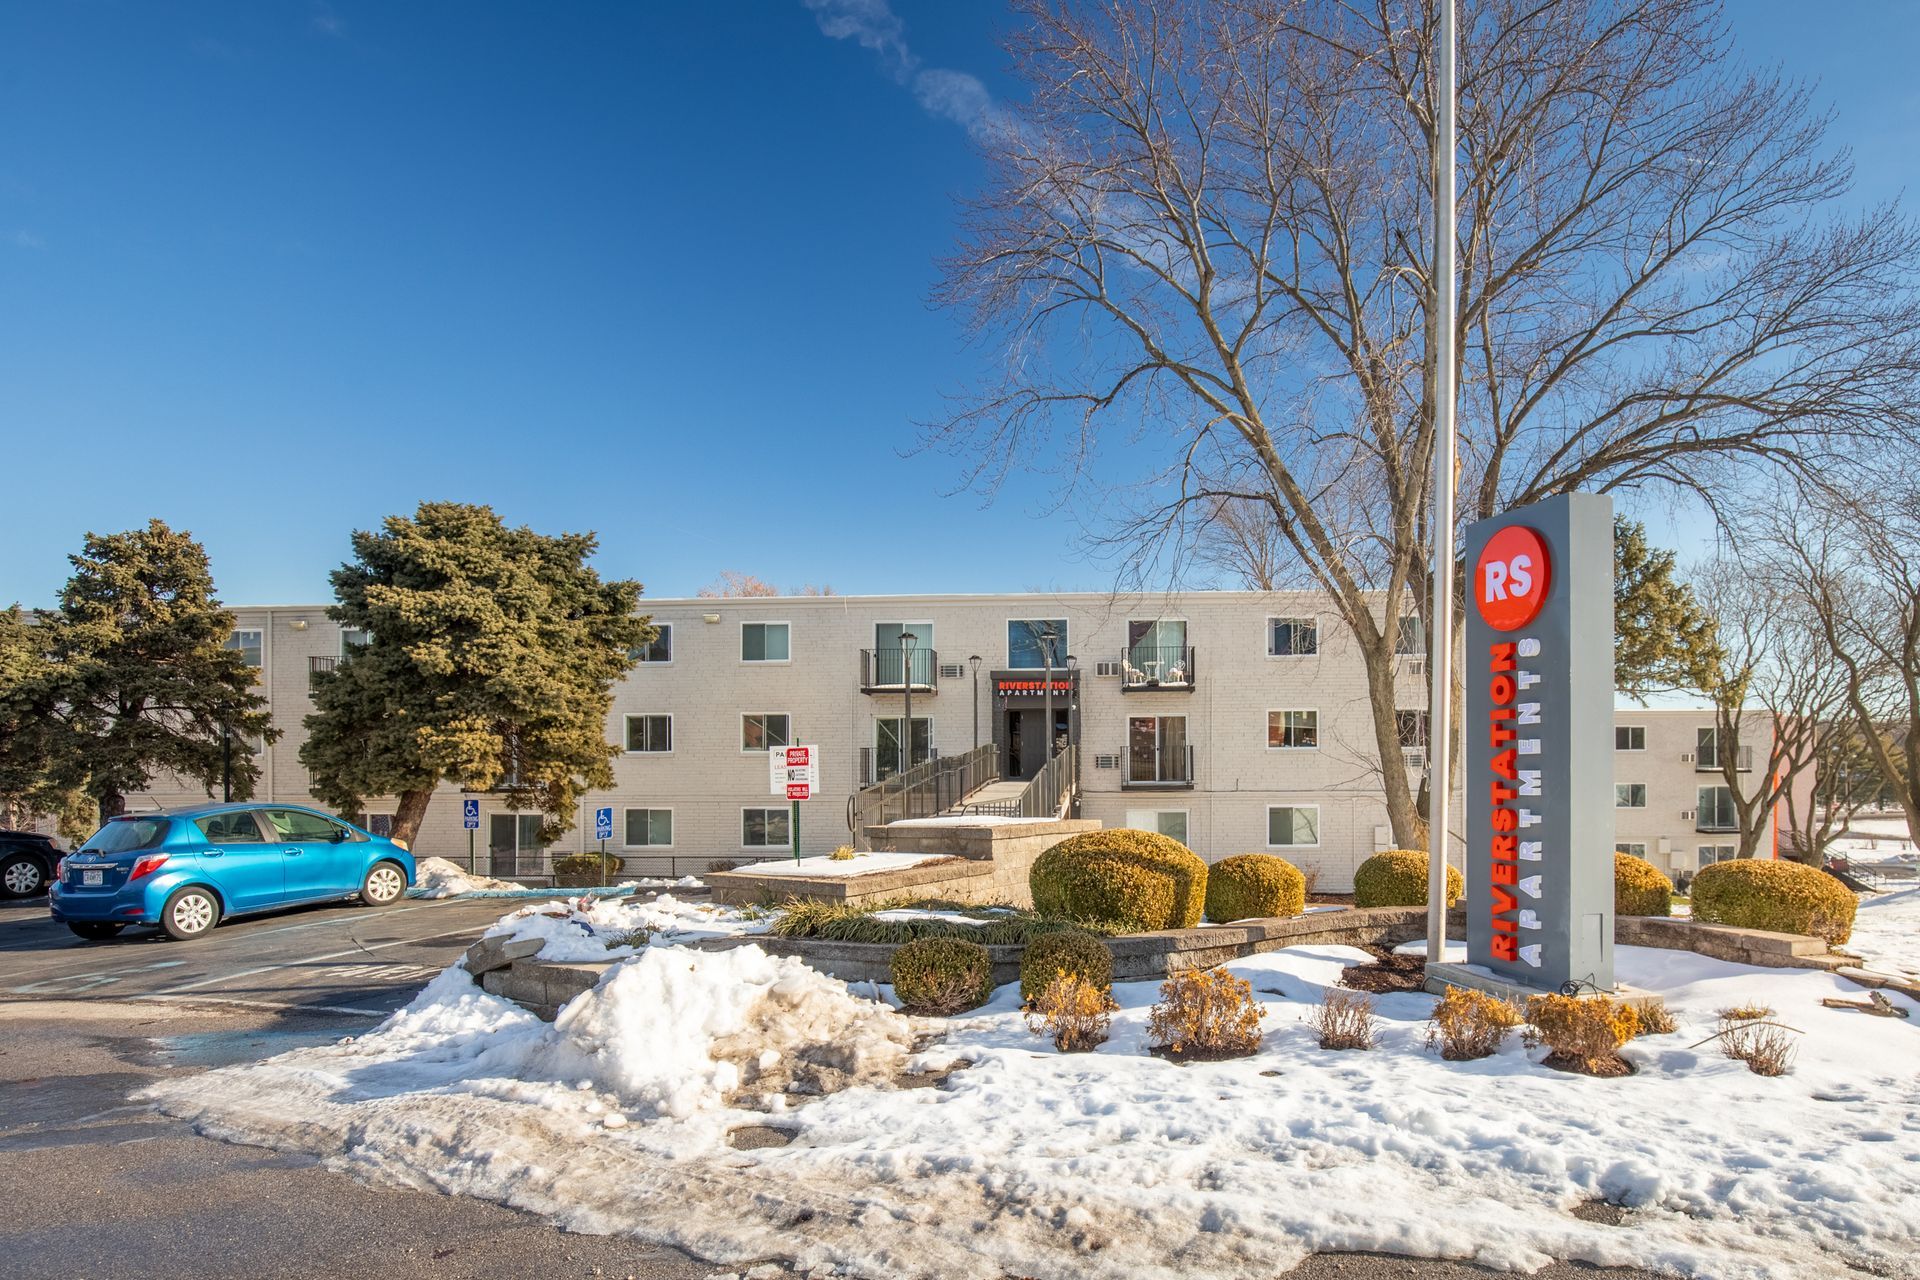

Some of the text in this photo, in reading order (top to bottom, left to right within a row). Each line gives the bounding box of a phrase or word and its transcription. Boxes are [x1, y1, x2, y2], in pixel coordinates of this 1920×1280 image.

[1485, 554, 1532, 604] RS
[788, 769, 795, 781] NO
[1490, 641, 1518, 963] RIVERSTATION
[1517, 637, 1543, 968] APARTMENTS
